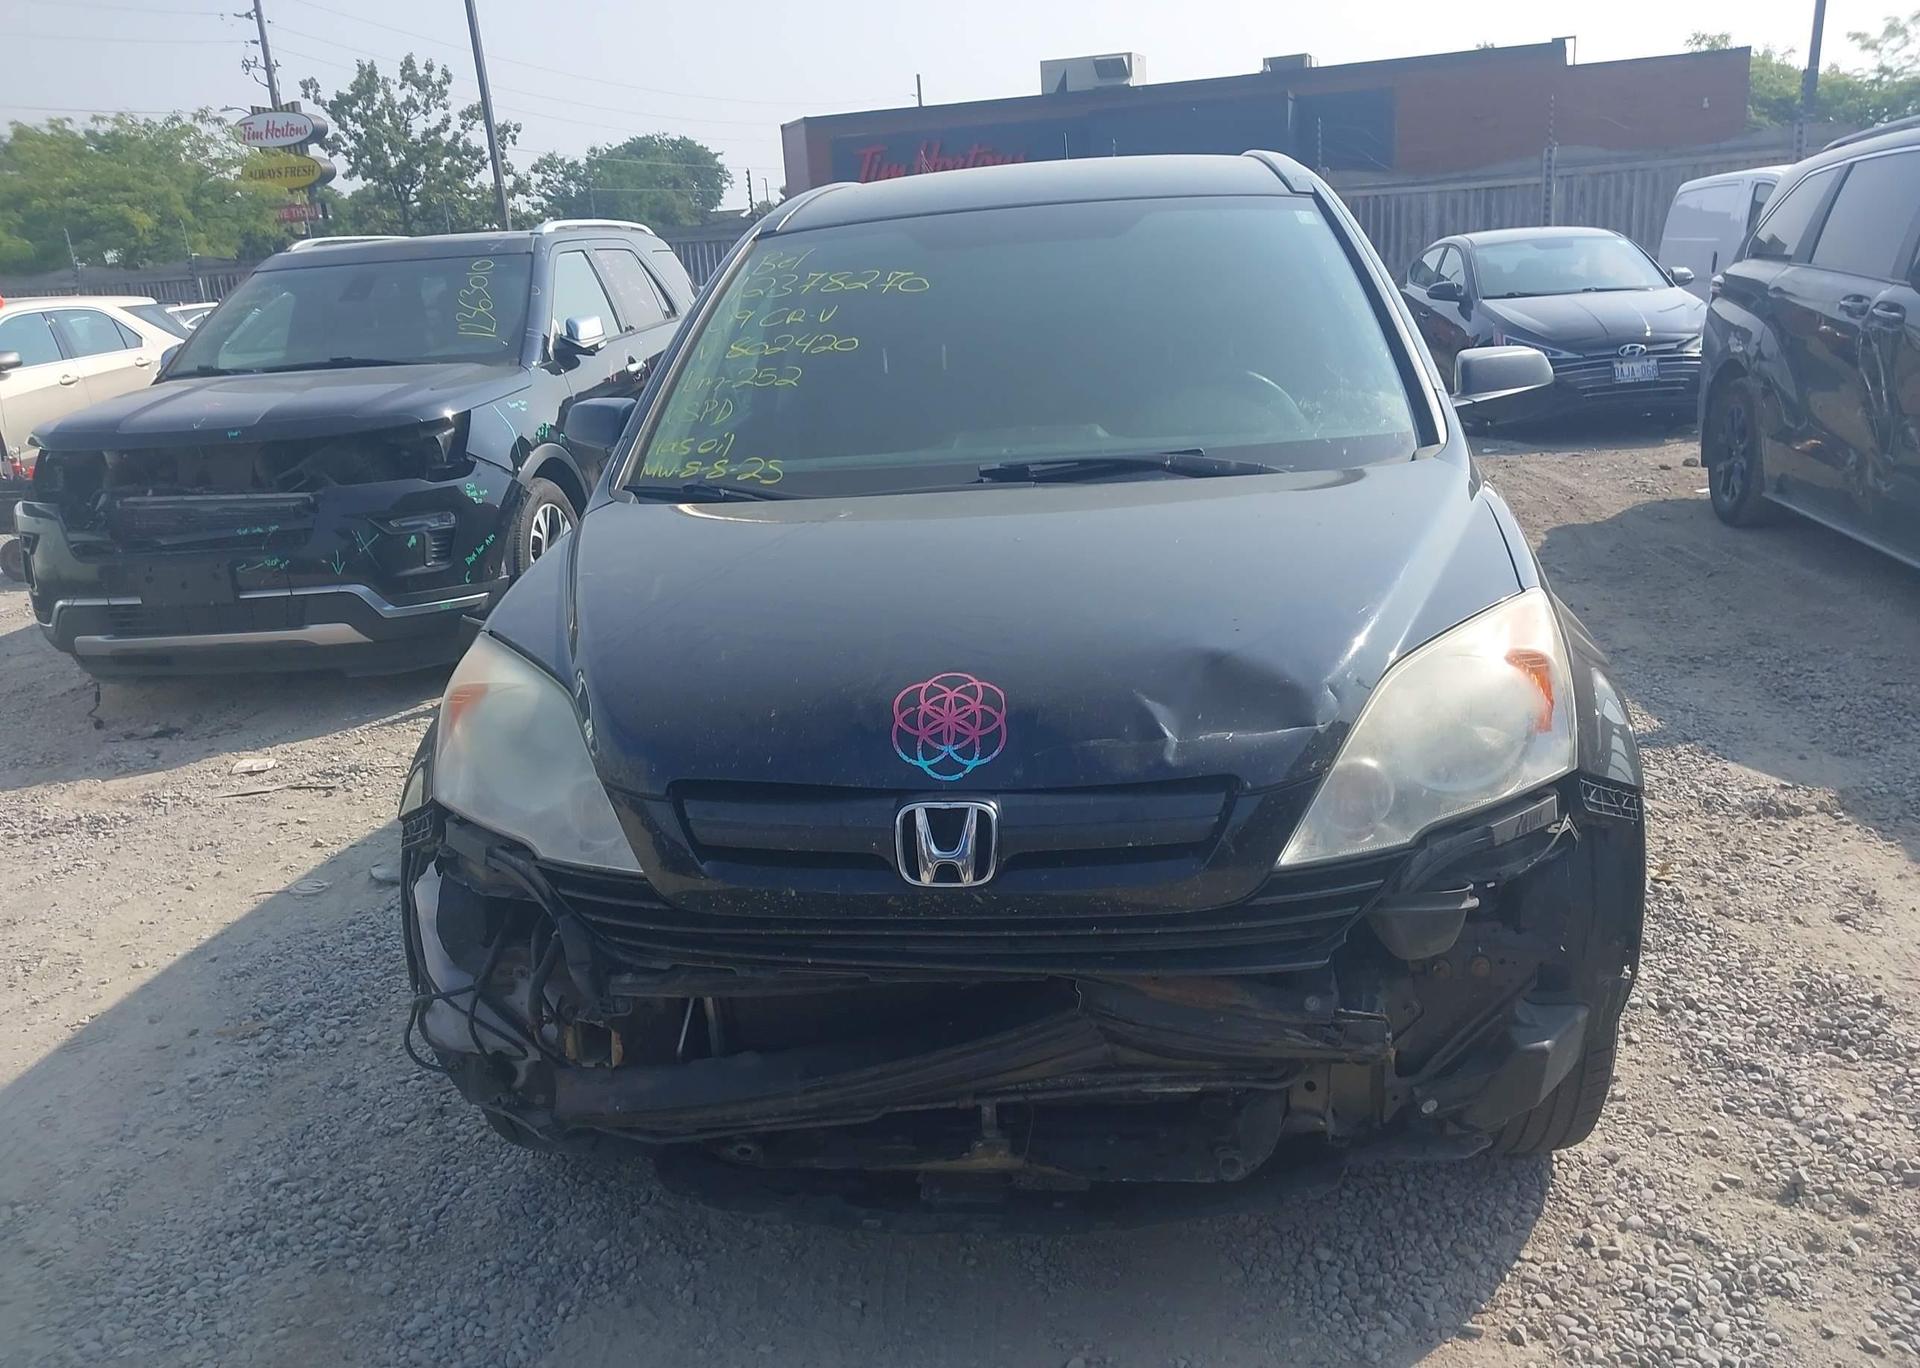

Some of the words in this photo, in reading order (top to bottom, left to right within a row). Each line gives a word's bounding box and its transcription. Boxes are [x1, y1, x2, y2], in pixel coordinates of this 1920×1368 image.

[239, 122, 264, 141] Tim
[265, 120, 309, 139] Hortons
[285, 165, 316, 179] FRESH
[854, 144, 906, 184] Tim
